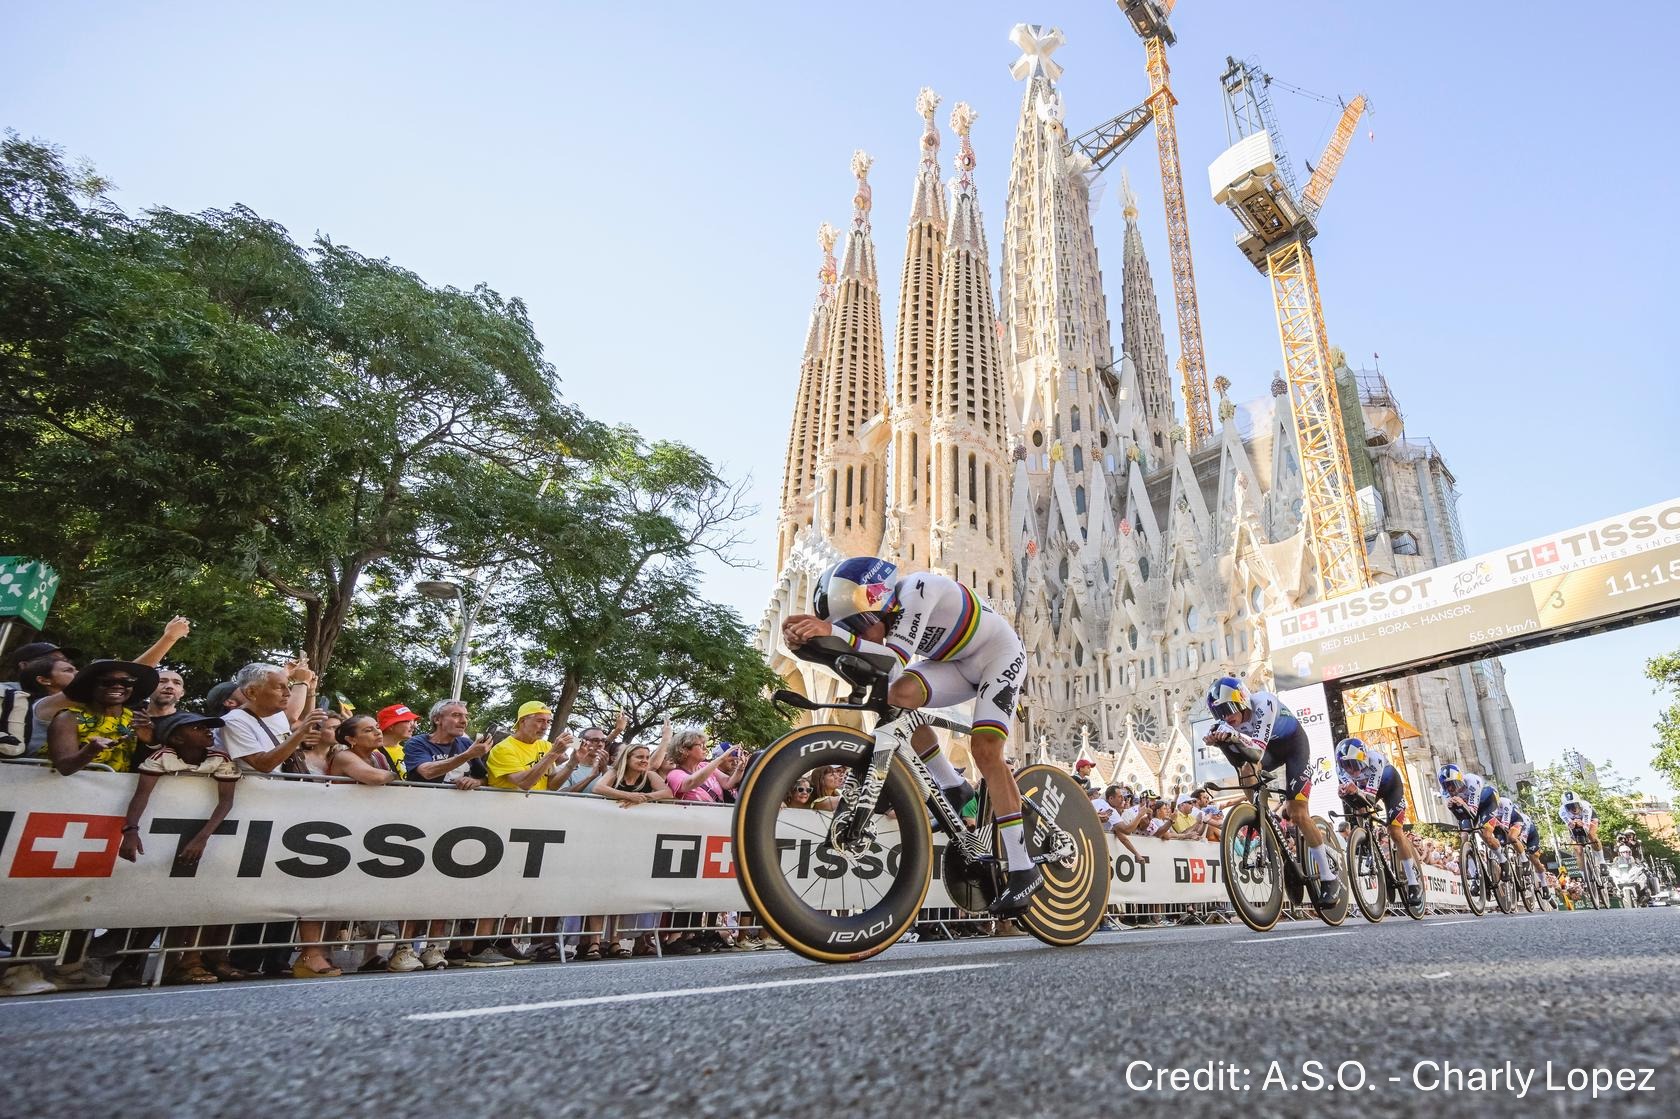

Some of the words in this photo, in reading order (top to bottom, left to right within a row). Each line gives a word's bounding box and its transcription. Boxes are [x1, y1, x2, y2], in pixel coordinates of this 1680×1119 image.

[1512, 568, 1553, 584] SWISS
[1560, 547, 1628, 571] WATCHES
[1320, 577, 1433, 624] TISSOT
[1550, 590, 1566, 609] 3
[909, 612, 922, 639] BORA
[1321, 638, 1341, 651] RED
[1344, 632, 1369, 646] BULL
[1378, 621, 1411, 637] BORA
[1420, 604, 1476, 626] HANSGR.
[1469, 627, 1504, 643] 55.93
[1506, 619, 1538, 634] km/h
[1002, 651, 1026, 682] BORA
[800, 740, 867, 757] roval
[149, 817, 566, 879] TISSOT
[827, 913, 894, 944] roval
